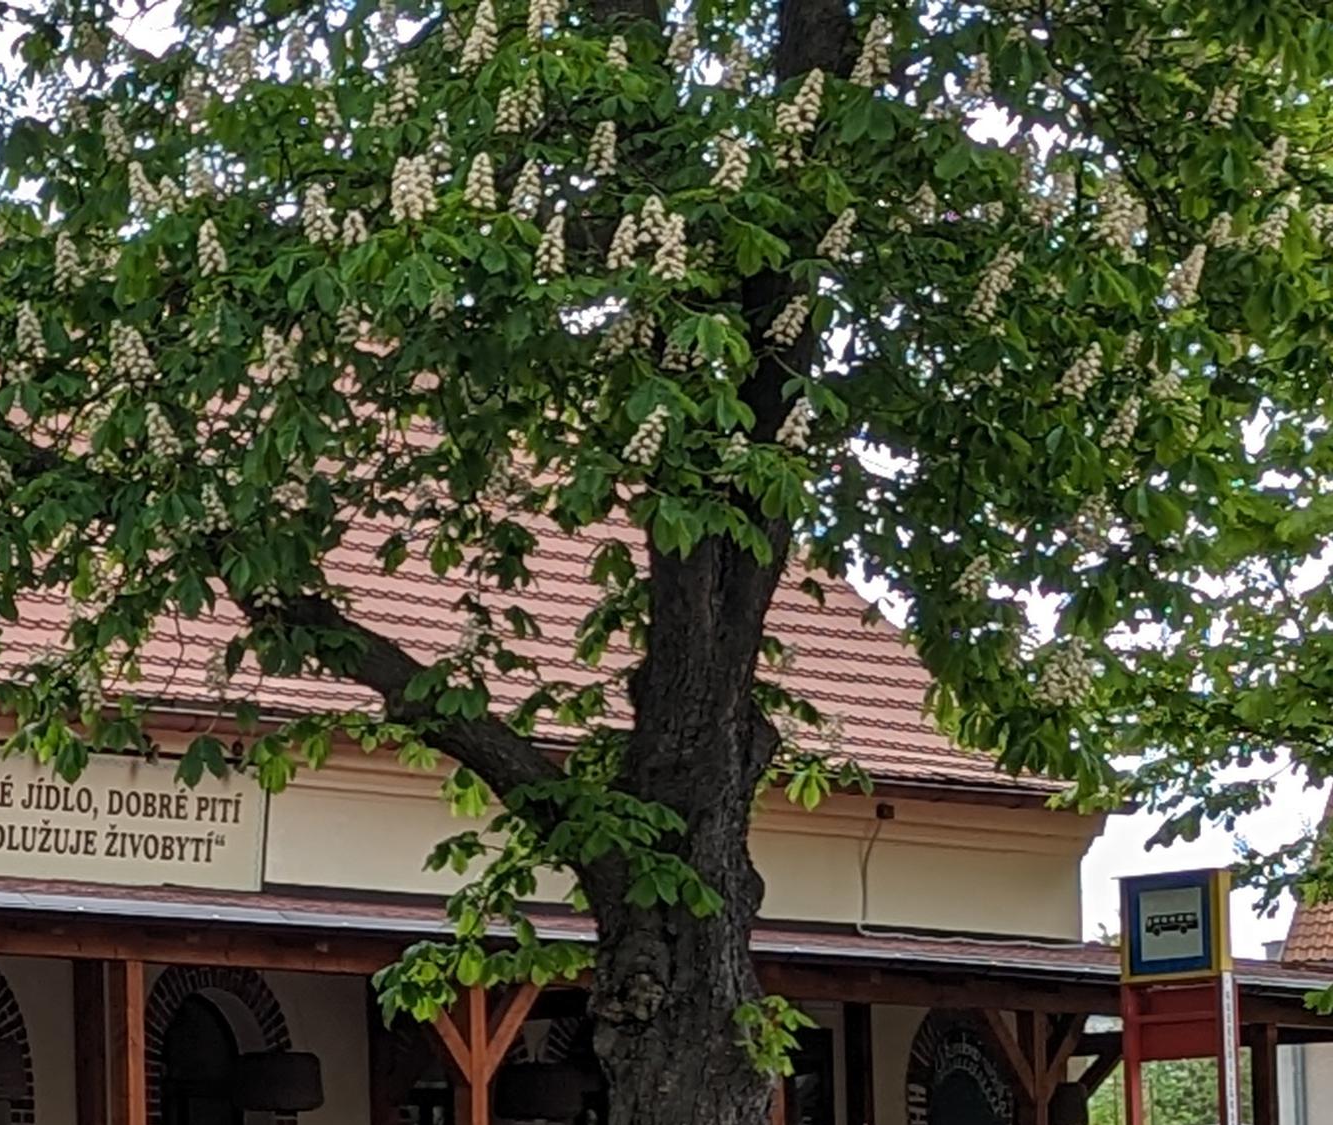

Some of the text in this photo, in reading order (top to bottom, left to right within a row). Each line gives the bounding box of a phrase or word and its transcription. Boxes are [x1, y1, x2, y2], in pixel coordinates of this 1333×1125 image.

[21, 777, 99, 820] JÍDLO,
[107, 788, 189, 821] DOBRÉ
[195, 792, 244, 824] PITÍ
